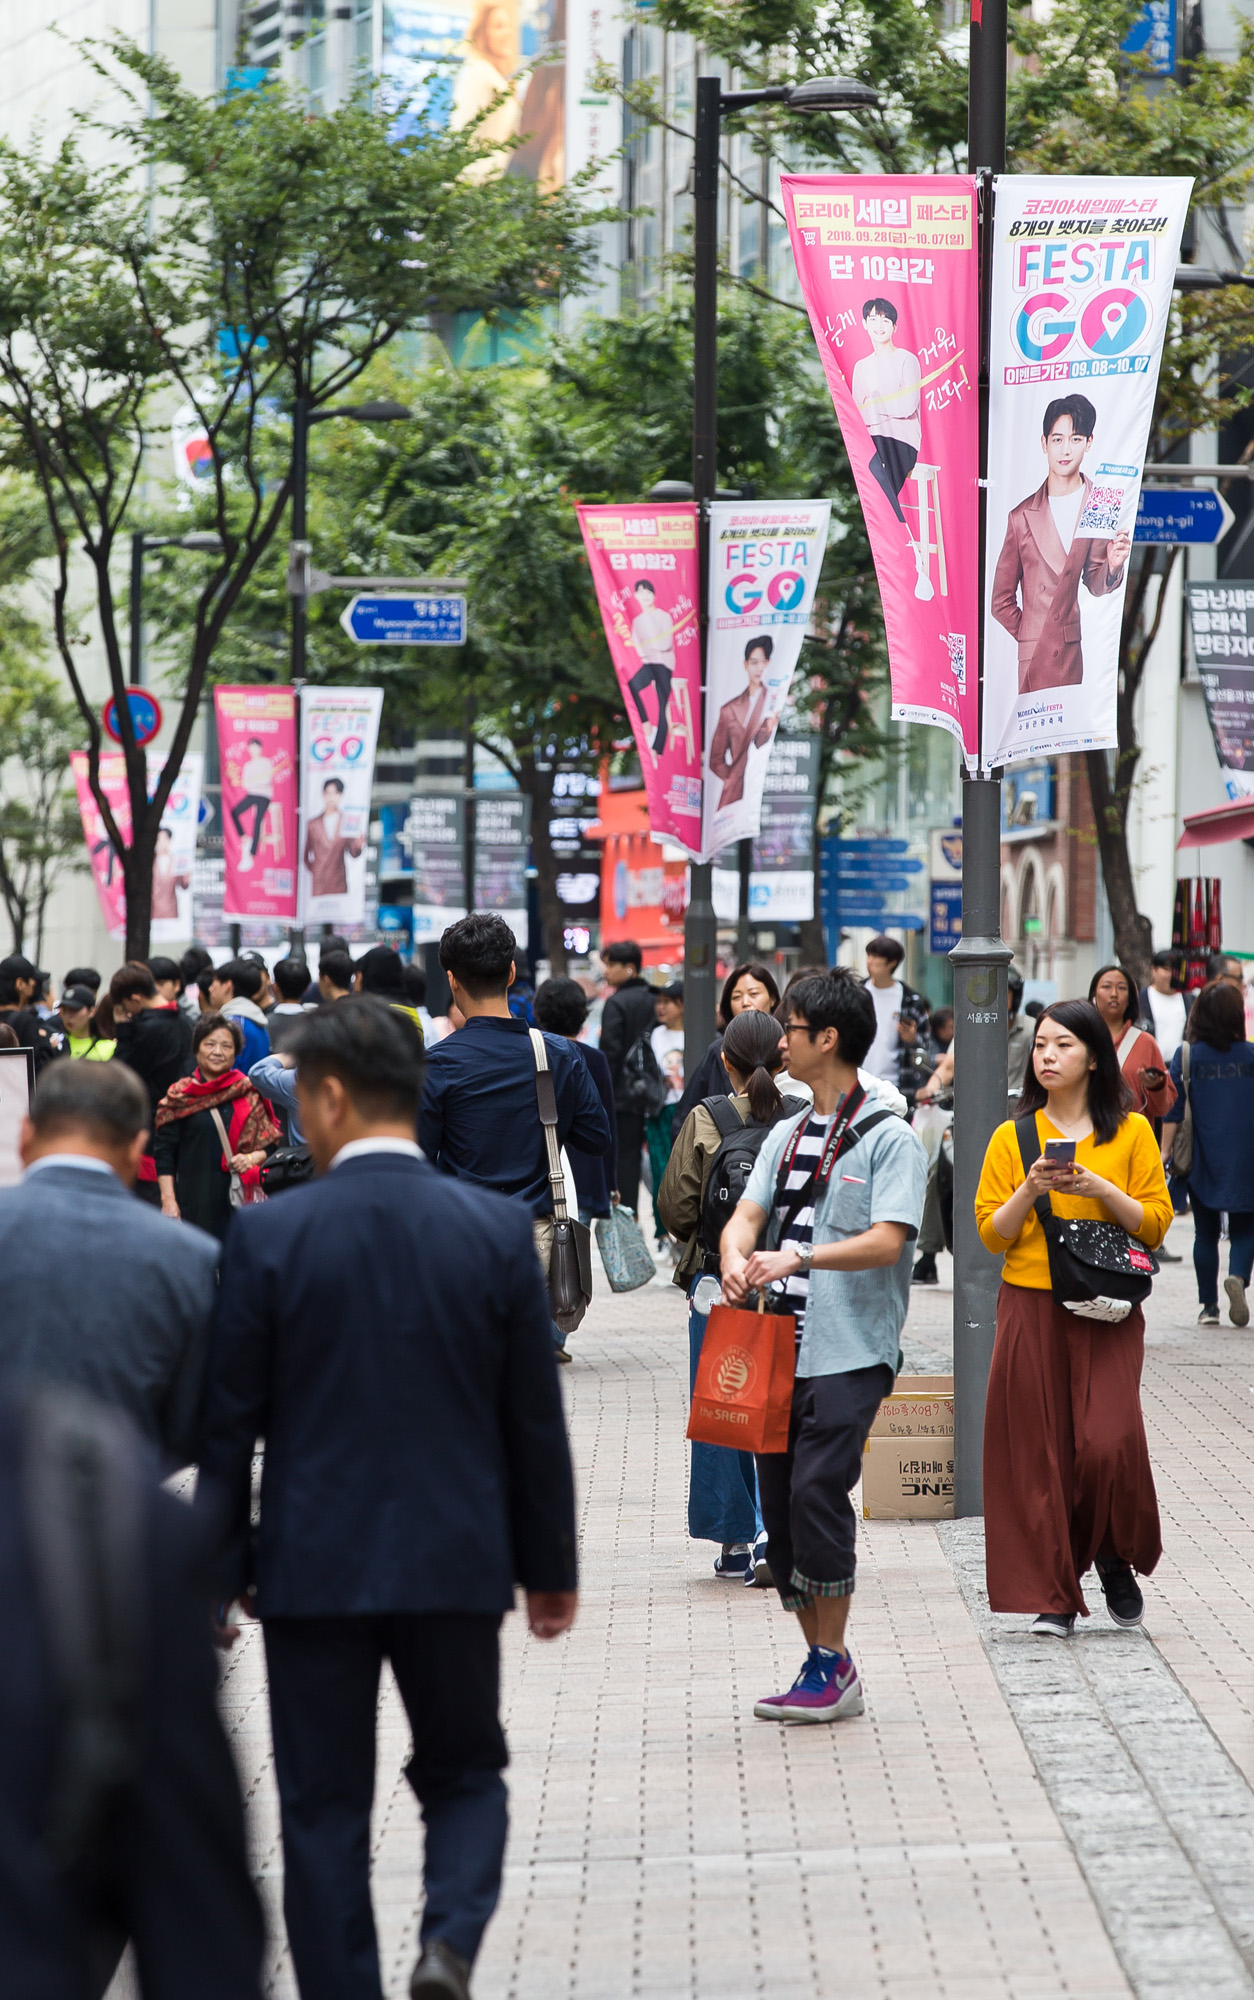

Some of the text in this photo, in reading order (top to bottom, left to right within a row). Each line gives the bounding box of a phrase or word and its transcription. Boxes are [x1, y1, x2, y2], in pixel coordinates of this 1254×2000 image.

[798, 198, 968, 225] 코리아 세일 페스타
[1022, 198, 1159, 215] 코리아세일페스타
[1009, 216, 1168, 237] 8개의 뱃지를 찾아라!
[829, 255, 935, 284] 단 10일간
[1018, 240, 1150, 287] FESTA
[1016, 287, 1147, 362] GO
[1005, 362, 1069, 384] 이벤트기간
[726, 541, 808, 570] FESTA
[725, 571, 805, 615] GO
[1192, 611, 1248, 635] 클래식
[1046, 703, 1064, 712] FESTA
[311, 736, 364, 762] GO
[967, 1012, 998, 1024] 서울중구
[821, 1152, 834, 1176] EOS
[828, 1138, 838, 1151] 7D
[715, 1408, 750, 1425] SAEM
[899, 1460, 942, 1474] 매대집기
